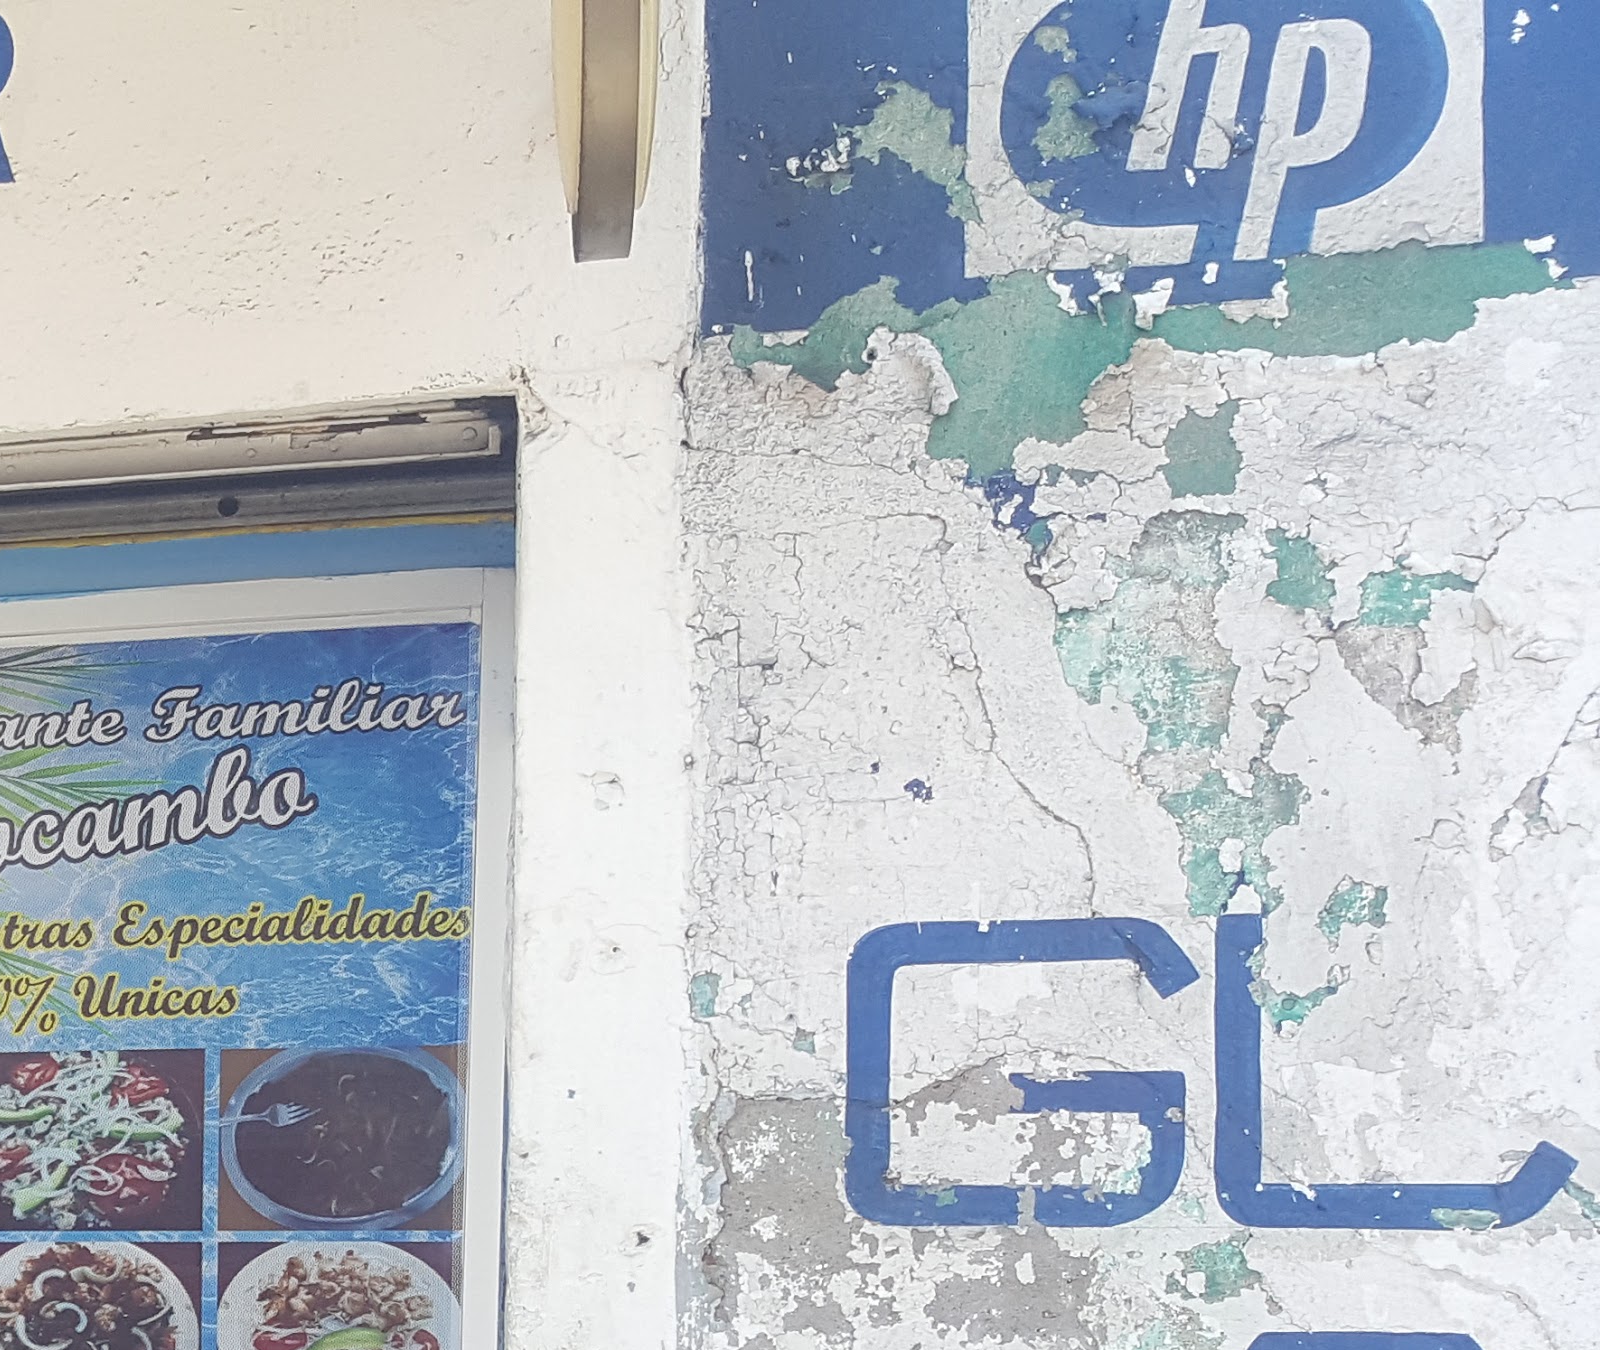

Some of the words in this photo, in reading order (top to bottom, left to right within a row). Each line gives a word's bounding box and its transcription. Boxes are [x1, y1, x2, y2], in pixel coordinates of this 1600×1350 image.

[1125, 0, 1372, 261] hp
[144, 678, 467, 742] Familiar
[112, 892, 469, 959] Especialidades
[71, 972, 239, 1020] Unicas
